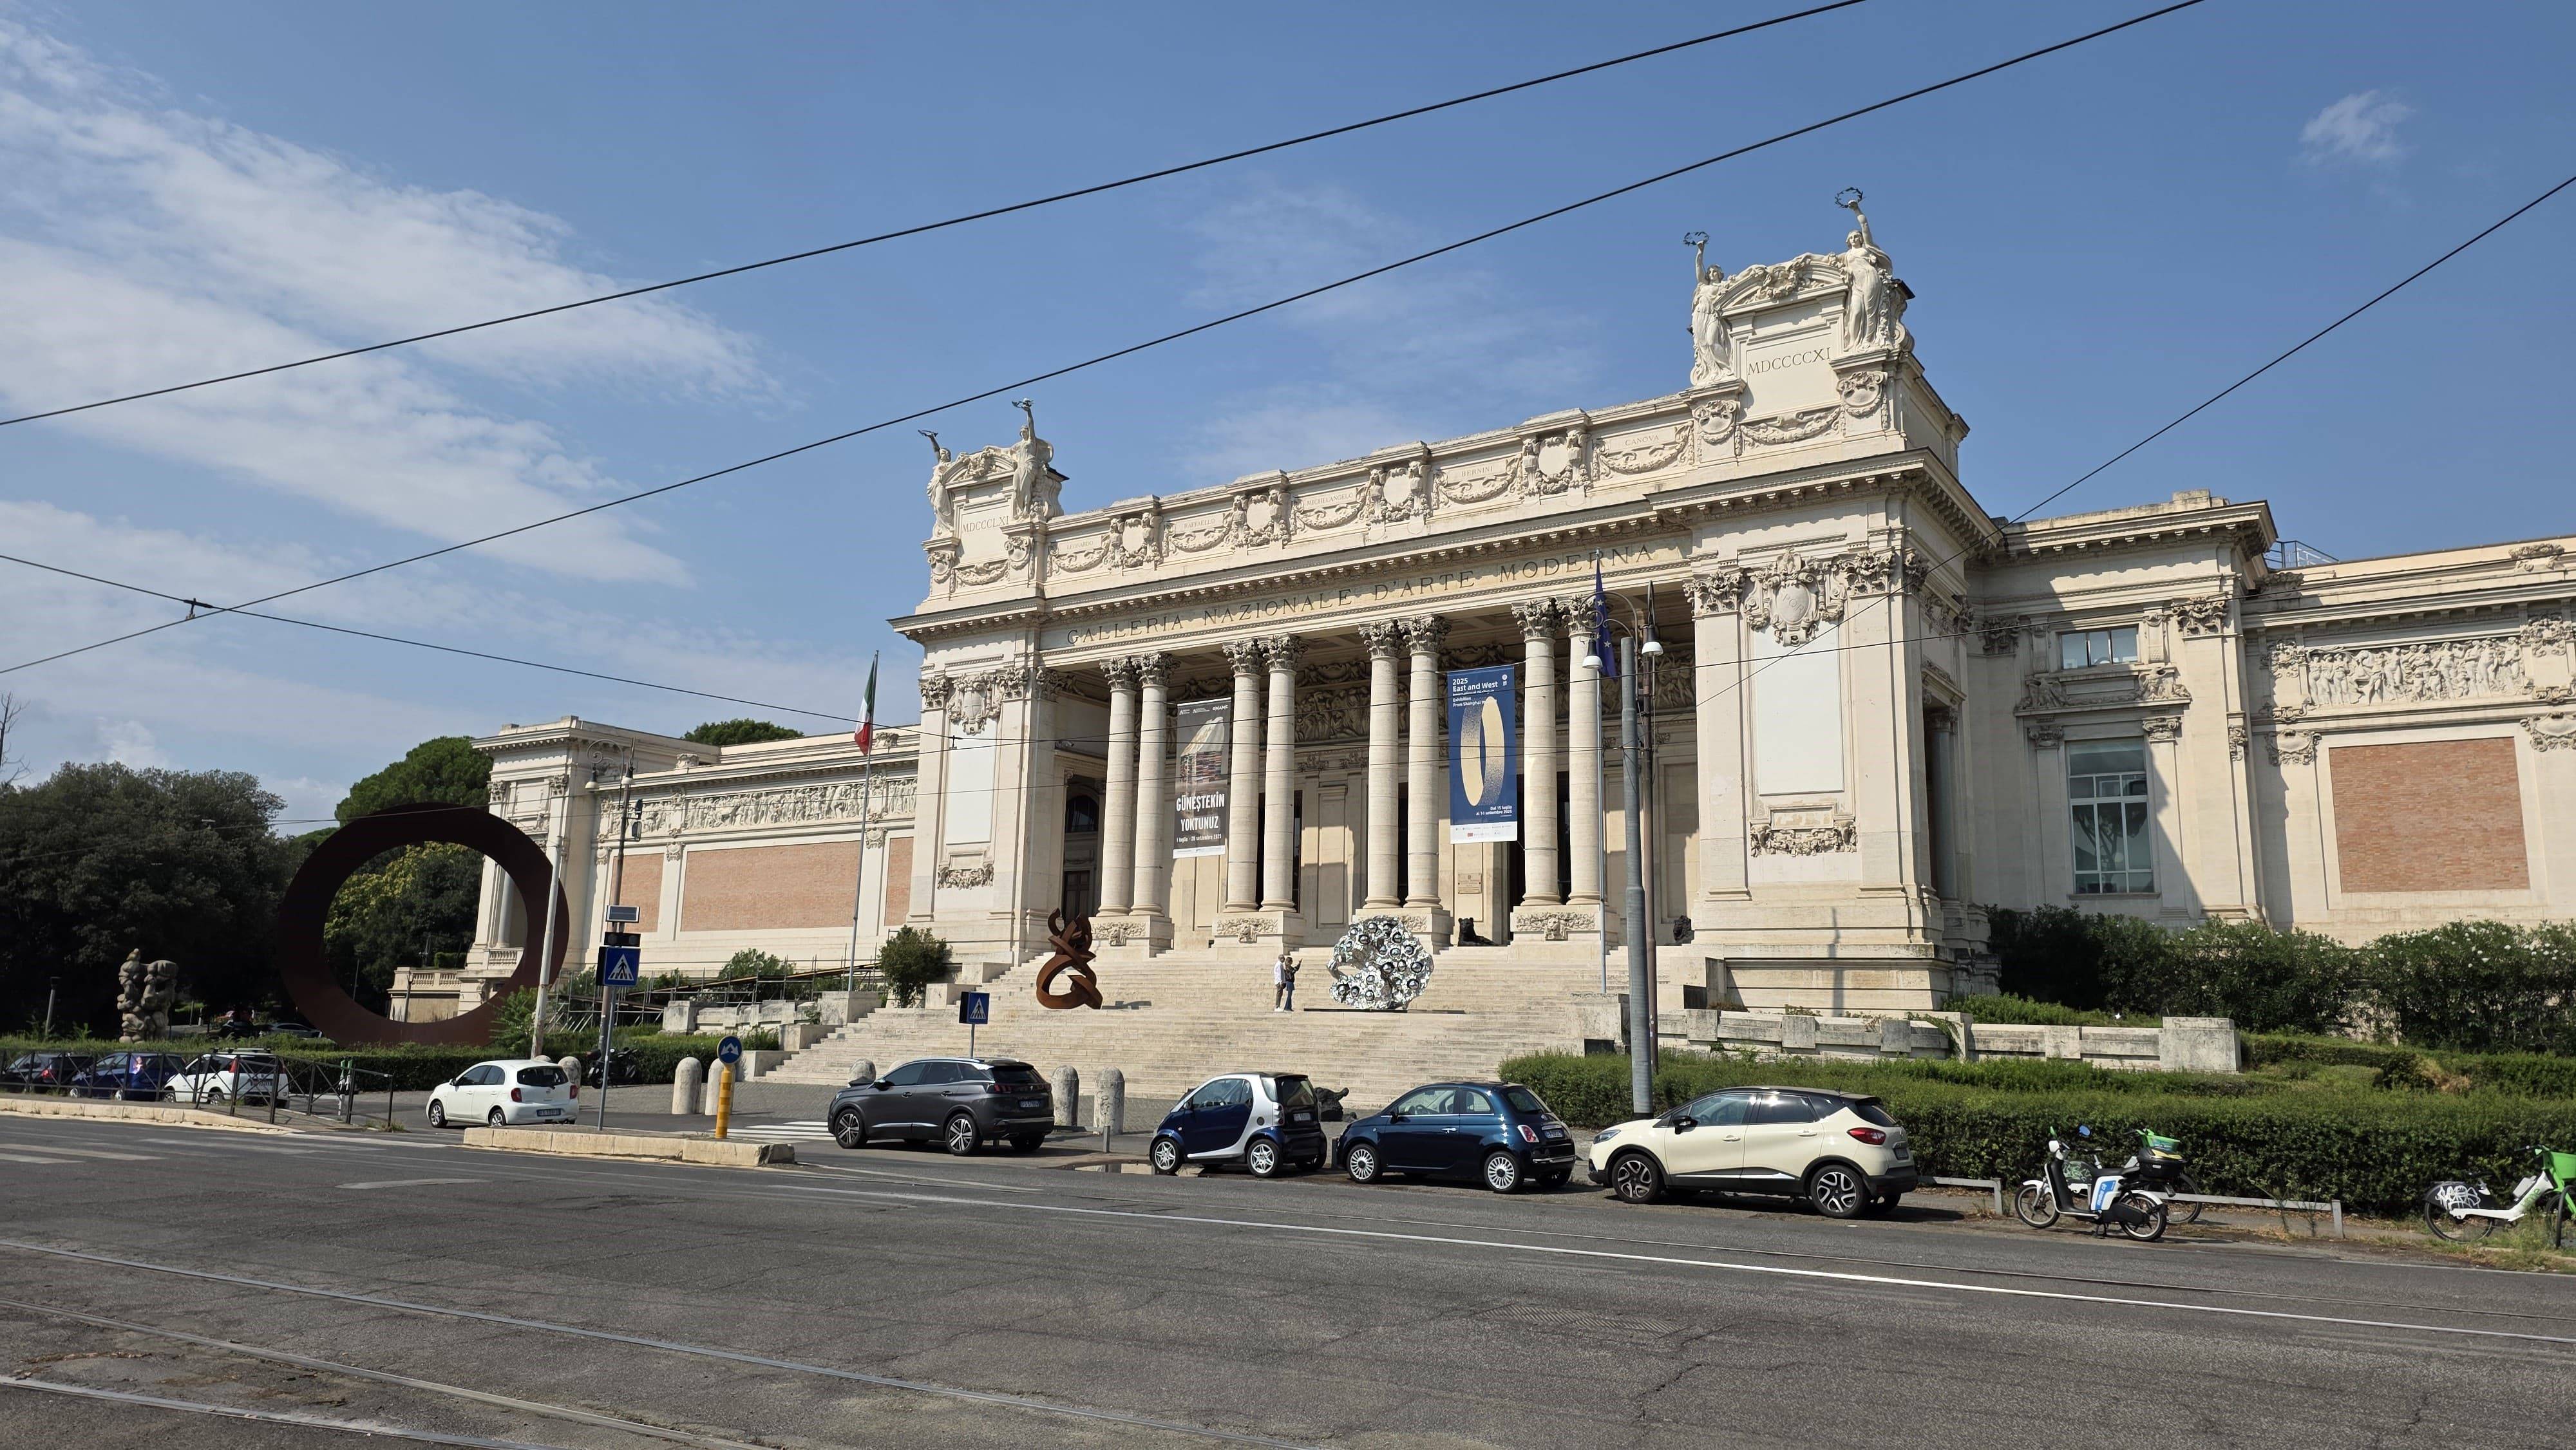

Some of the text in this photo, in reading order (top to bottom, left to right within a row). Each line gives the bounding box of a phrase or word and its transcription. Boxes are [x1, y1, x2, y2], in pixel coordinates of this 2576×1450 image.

[1748, 347, 1833, 376] MDCCCCXI
[1625, 435, 1660, 446] CANOVA
[1461, 465, 1493, 478] BERNINI
[1307, 492, 1353, 505] MICHELANGELO
[963, 515, 1009, 533] MDCCCLXI
[1184, 518, 1216, 529] RAFFAELLO
[1067, 543, 1654, 645] GALLERIA NAZIONALE D'ARTE MODERNA
[1176, 791, 1225, 812] GÜNEŞTEKİN
[1180, 815, 1219, 832] YOKTUNUZ
